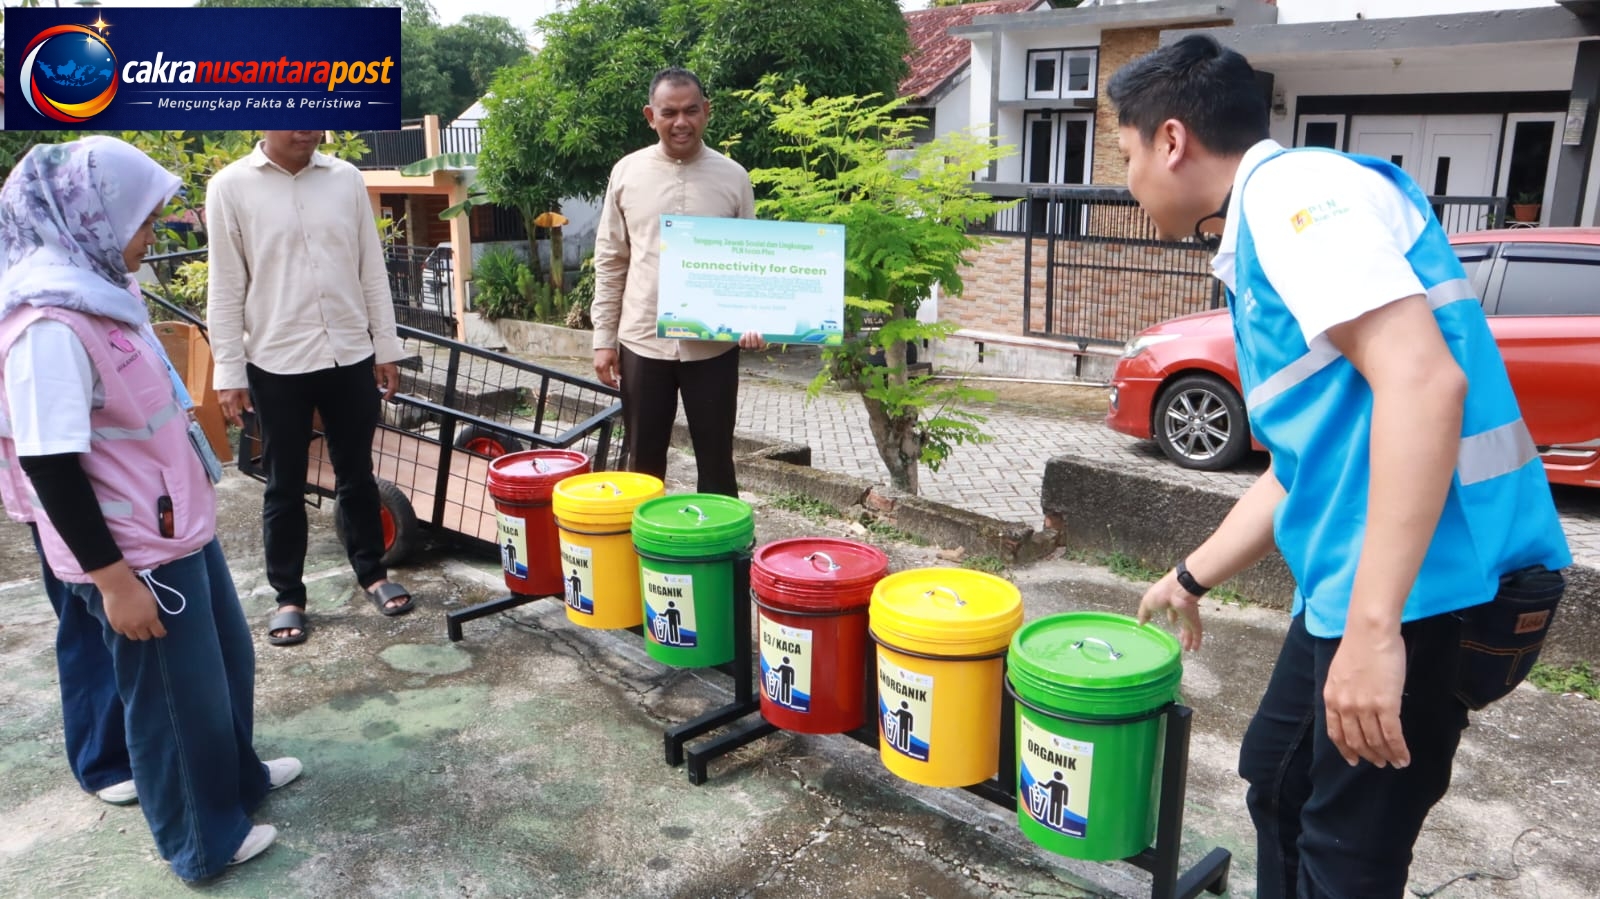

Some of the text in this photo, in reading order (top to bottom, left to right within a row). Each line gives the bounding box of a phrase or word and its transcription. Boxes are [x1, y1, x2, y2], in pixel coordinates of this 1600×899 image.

[682, 259, 827, 276] Iconnectivity for Green
[648, 582, 683, 598] ORGANIK
[879, 668, 927, 702] ANORGANIK
[1028, 738, 1077, 770] ORGANIK
